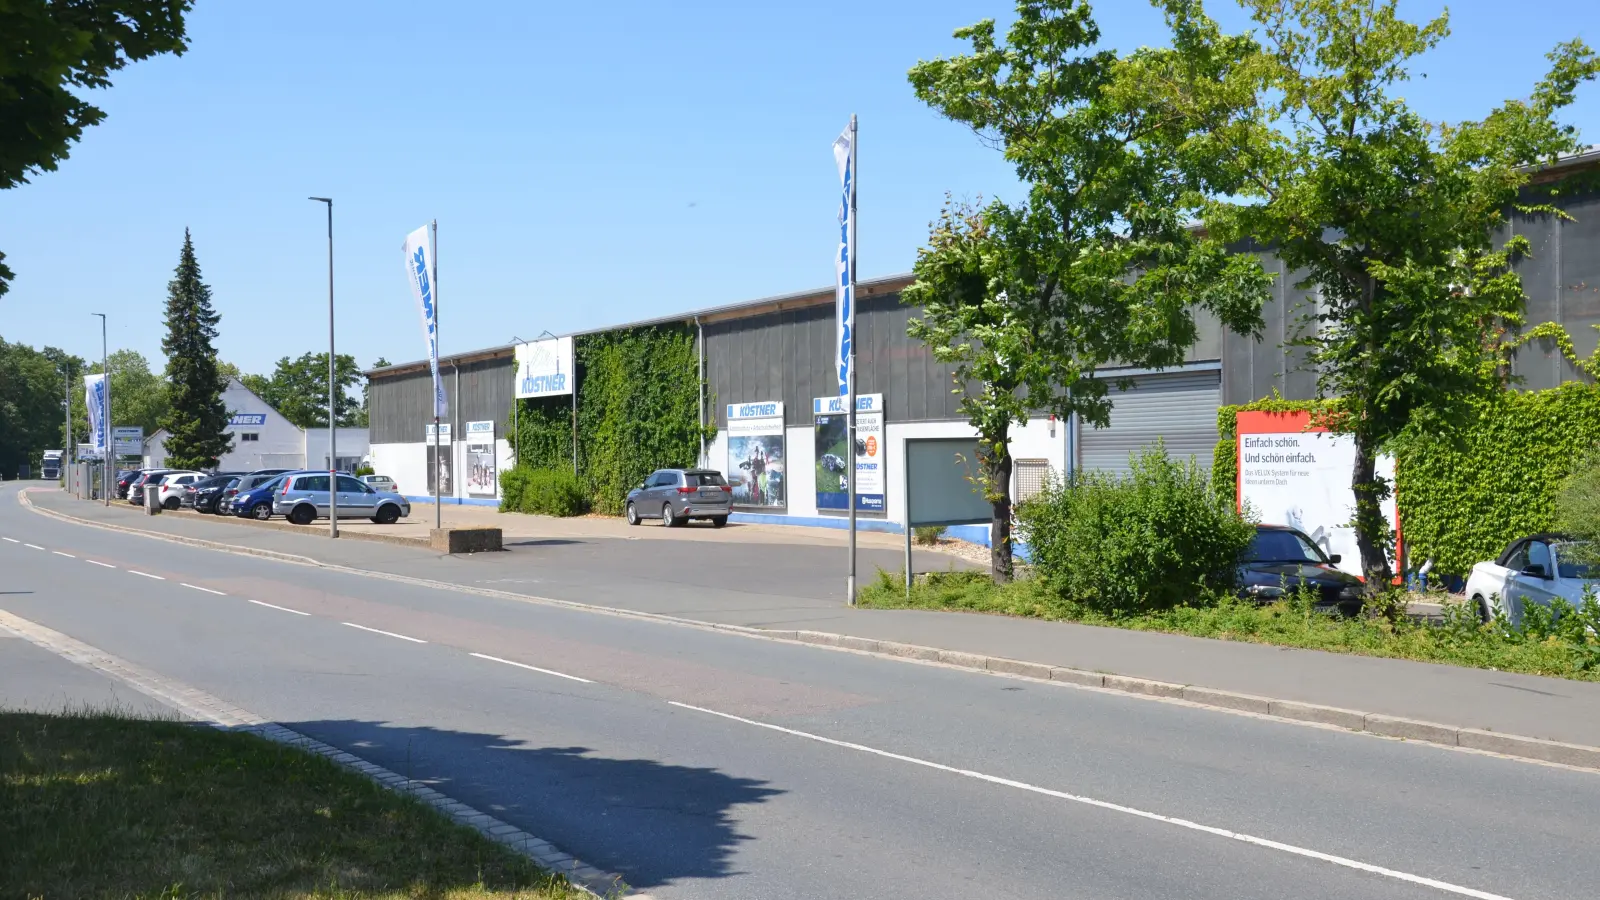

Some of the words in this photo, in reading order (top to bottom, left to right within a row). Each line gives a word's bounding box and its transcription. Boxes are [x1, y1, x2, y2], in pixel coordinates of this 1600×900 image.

[1245, 437, 1273, 448] Einfach
[1275, 437, 1300, 448] schön.
[1245, 452, 1260, 463] Und
[1262, 452, 1284, 463] schön
[1286, 452, 1316, 463] einfach.
[1255, 469, 1270, 477] VELUX
[1271, 469, 1289, 478] System
